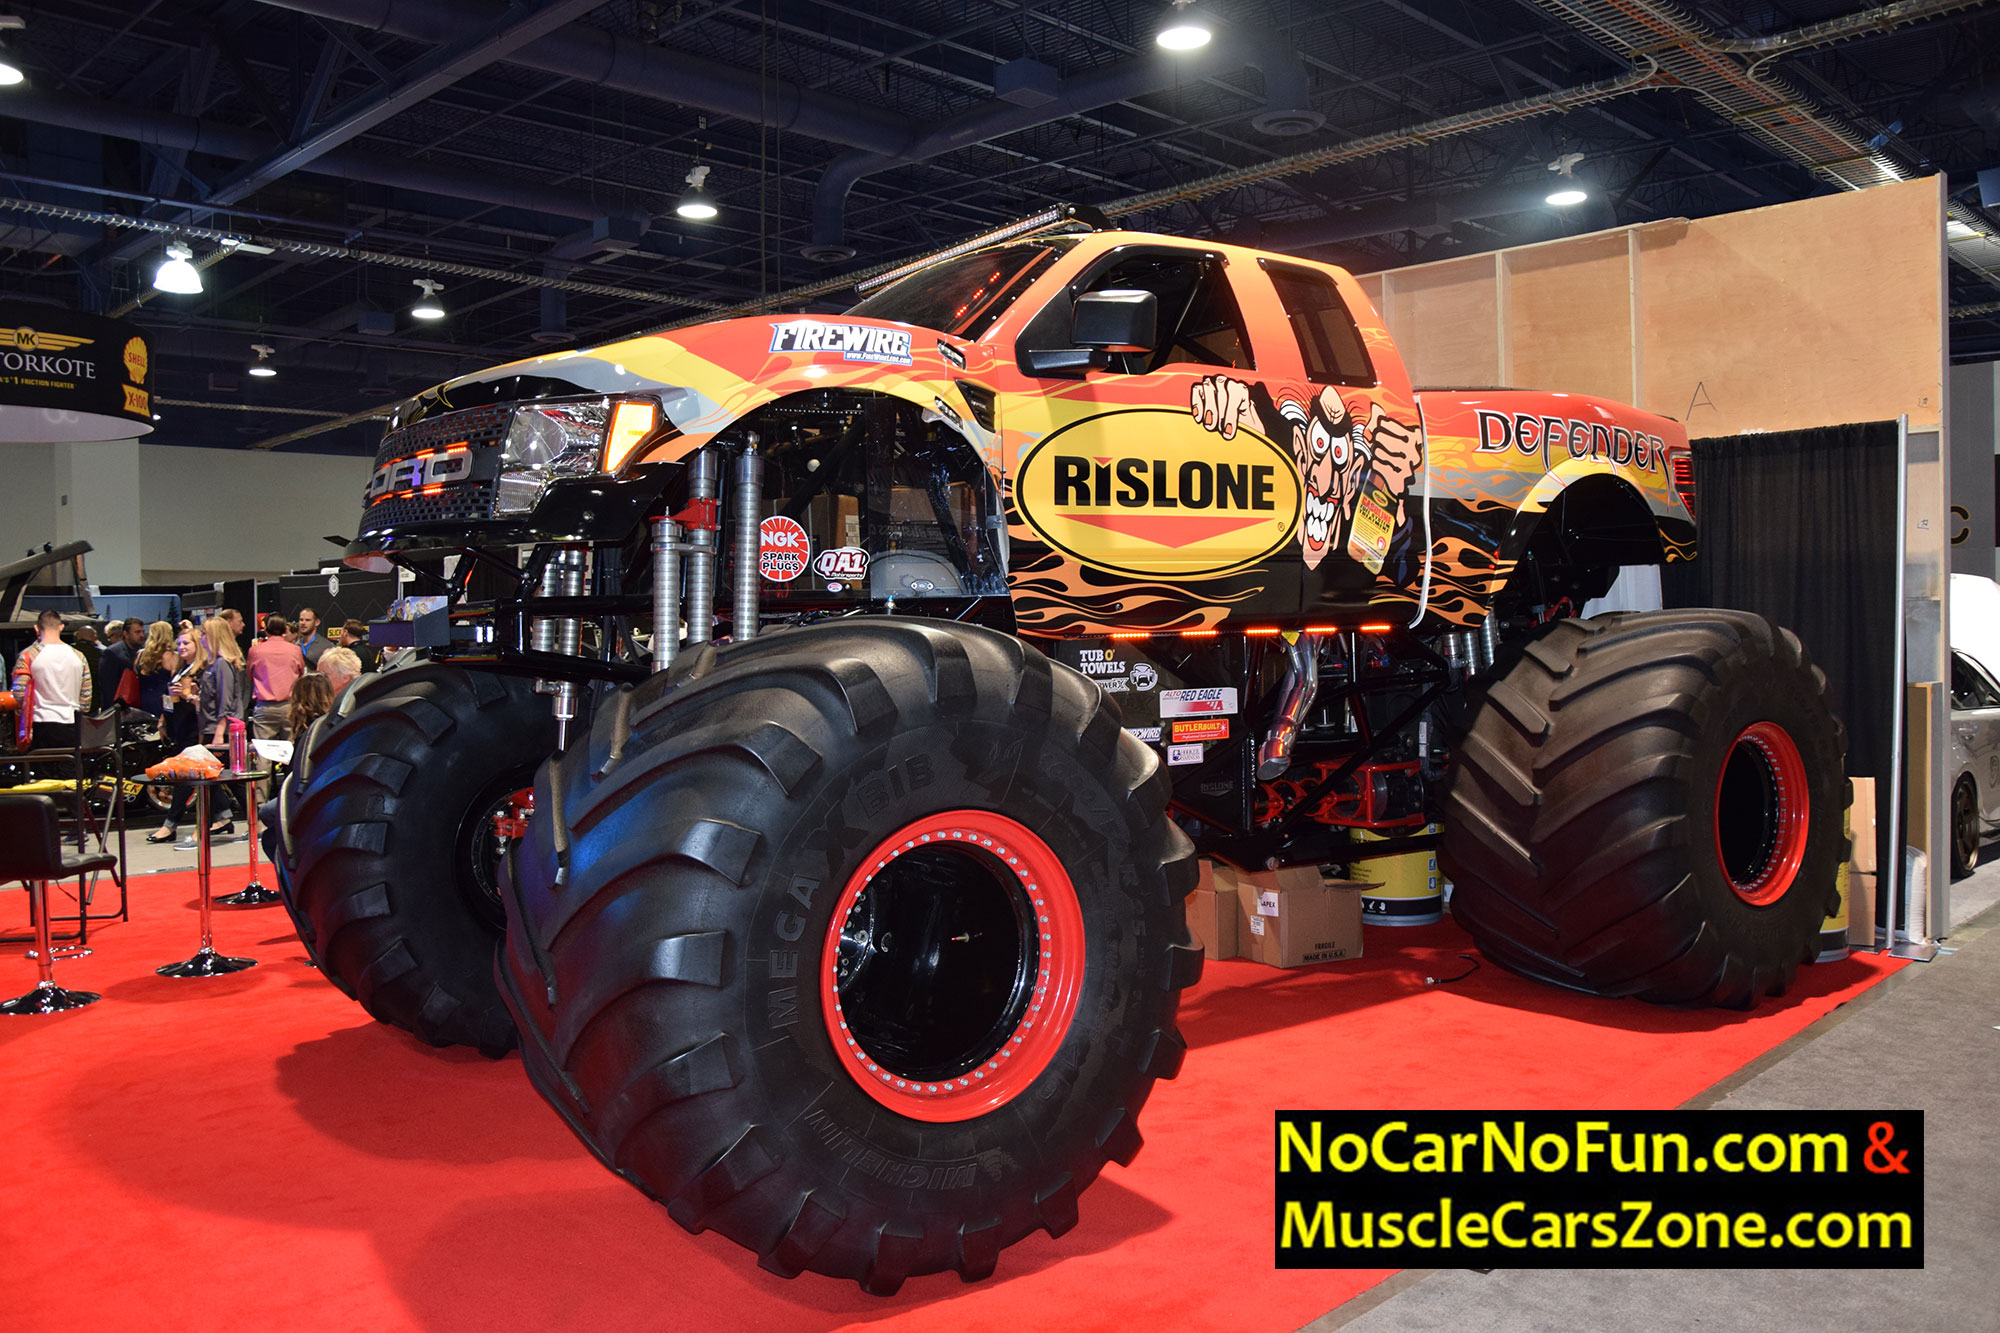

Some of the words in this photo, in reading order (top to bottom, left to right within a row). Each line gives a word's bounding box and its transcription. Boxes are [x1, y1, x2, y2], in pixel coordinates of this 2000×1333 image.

[16, 332, 36, 346] MK
[773, 325, 910, 355] FIREWIRE
[128, 353, 146, 368] SHELL
[128, 391, 147, 411] X-100
[1686, 381, 1717, 421] A
[1473, 409, 1671, 490] DEFENDER
[364, 448, 473, 503] ORD
[1054, 456, 1275, 511] RISLONE
[761, 531, 799, 548] NGK
[762, 552, 798, 561] SPARK
[820, 552, 864, 576] QA1
[762, 562, 799, 571] PLUGS
[1080, 650, 1104, 661] TUB
[1080, 661, 1126, 674] TOWELS
[1180, 690, 1197, 701] RED
[1197, 689, 1222, 700] EAGLE
[1174, 722, 1220, 732] BUTLERBUILT
[1315, 942, 1335, 950] FRAGILE
[1304, 952, 1320, 961] MADE
[804, 1109, 977, 1189] MICHELIN
